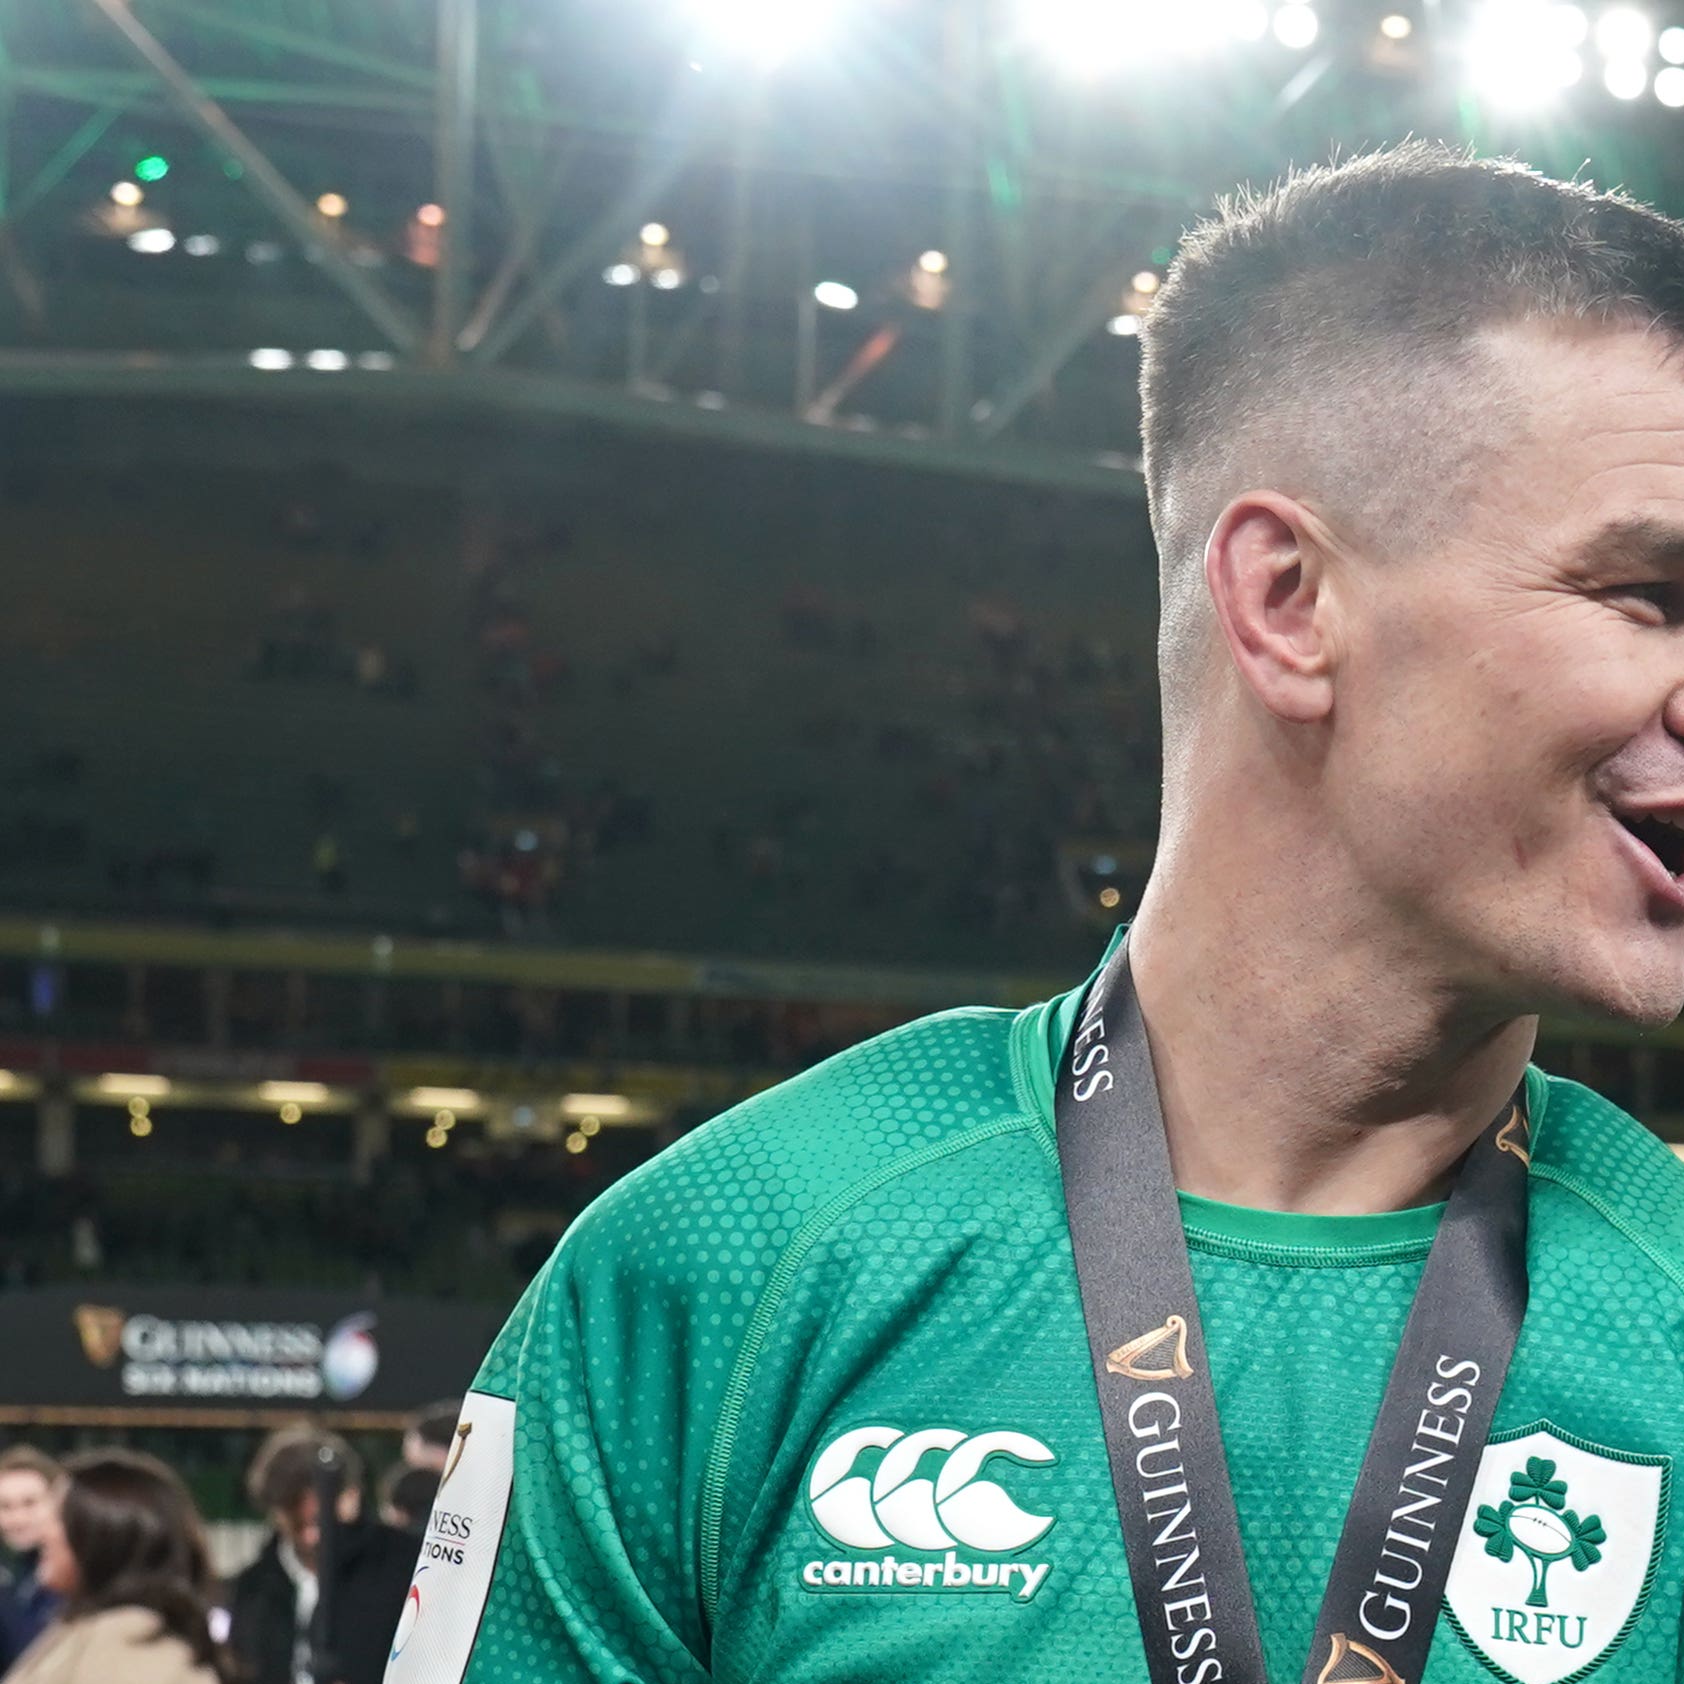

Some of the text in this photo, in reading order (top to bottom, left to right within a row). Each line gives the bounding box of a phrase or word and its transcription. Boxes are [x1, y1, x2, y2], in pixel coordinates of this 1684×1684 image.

[1359, 1354, 1481, 1640] GUINNESS
[802, 1551, 1050, 1599] canterbury
[1490, 1606, 1588, 1649] IRFU
